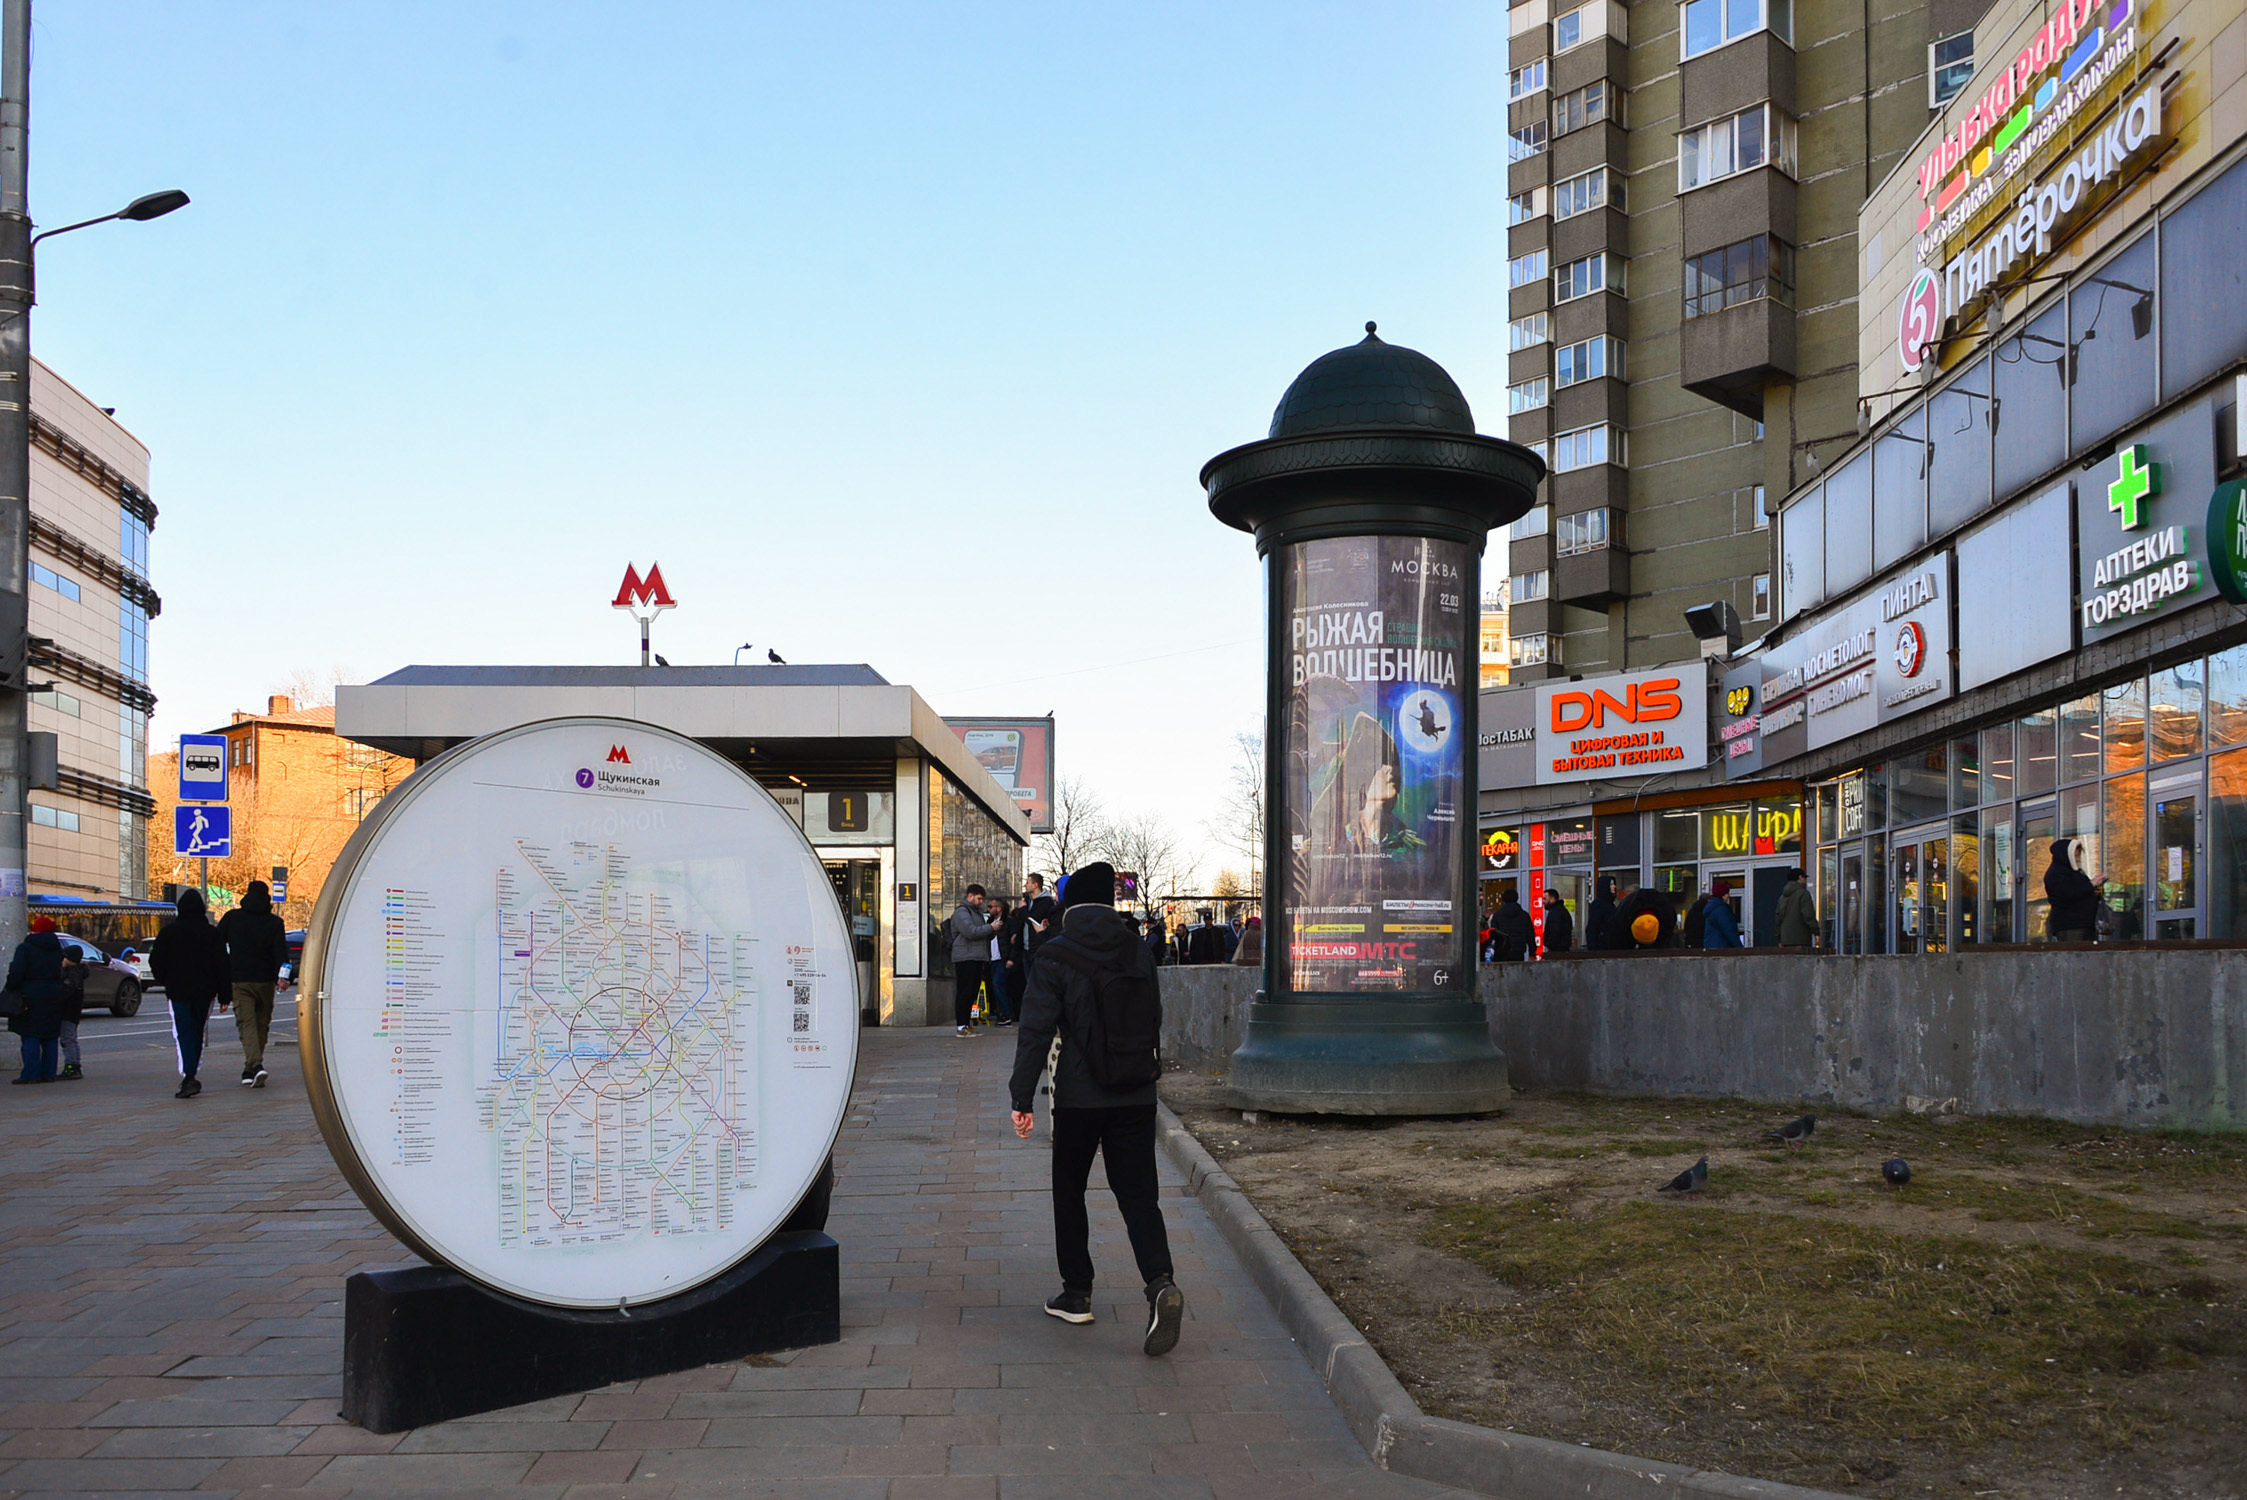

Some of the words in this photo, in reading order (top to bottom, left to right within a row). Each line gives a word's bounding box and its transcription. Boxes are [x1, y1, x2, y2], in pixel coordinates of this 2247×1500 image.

[1917, 177, 1994, 263] КОСМЕТИКА
[2003, 92, 2073, 179] БЫТОВАЯ
[2074, 27, 2134, 108] ХИМИЯ
[1945, 86, 2160, 319] Пятёрочка
[2094, 526, 2182, 588] АПТЕКИ
[1391, 560, 1458, 579] МОСКВА
[1323, 600, 1369, 610] Колесникова
[1440, 593, 1459, 607] 22.03
[1881, 573, 1937, 622] ПИНТА
[2083, 561, 2197, 628] ГОРЗДРАВ
[1292, 611, 1384, 651] РЫЖАЯ
[1804, 627, 1875, 680] КОСМЕТОЛОГ
[1293, 648, 1456, 688] ВОЛШЕБНИЦА
[1551, 678, 1682, 733] DNS
[1721, 714, 1760, 741] СМЕШНЫЕ
[1570, 733, 1648, 755] ЦИФРОВАЯ
[1651, 731, 1664, 744] И
[1729, 738, 1753, 758] ЦЕНЫ
[1552, 751, 1615, 772] БЫТОВАЯ
[1618, 746, 1684, 766] ТЕХНИКА
[598, 771, 660, 786] Щукинская
[598, 784, 645, 795] Schukinskaya
[842, 797, 852, 821] 1
[1481, 841, 1518, 856] ПЕКАРНЯ
[1551, 831, 1593, 843] СМЕШНЫЕ
[1559, 844, 1584, 854] ЦЕНЫ
[904, 885, 911, 897] 1
[1291, 946, 1357, 956] TICKETLAND
[1433, 970, 1449, 985] 6+
